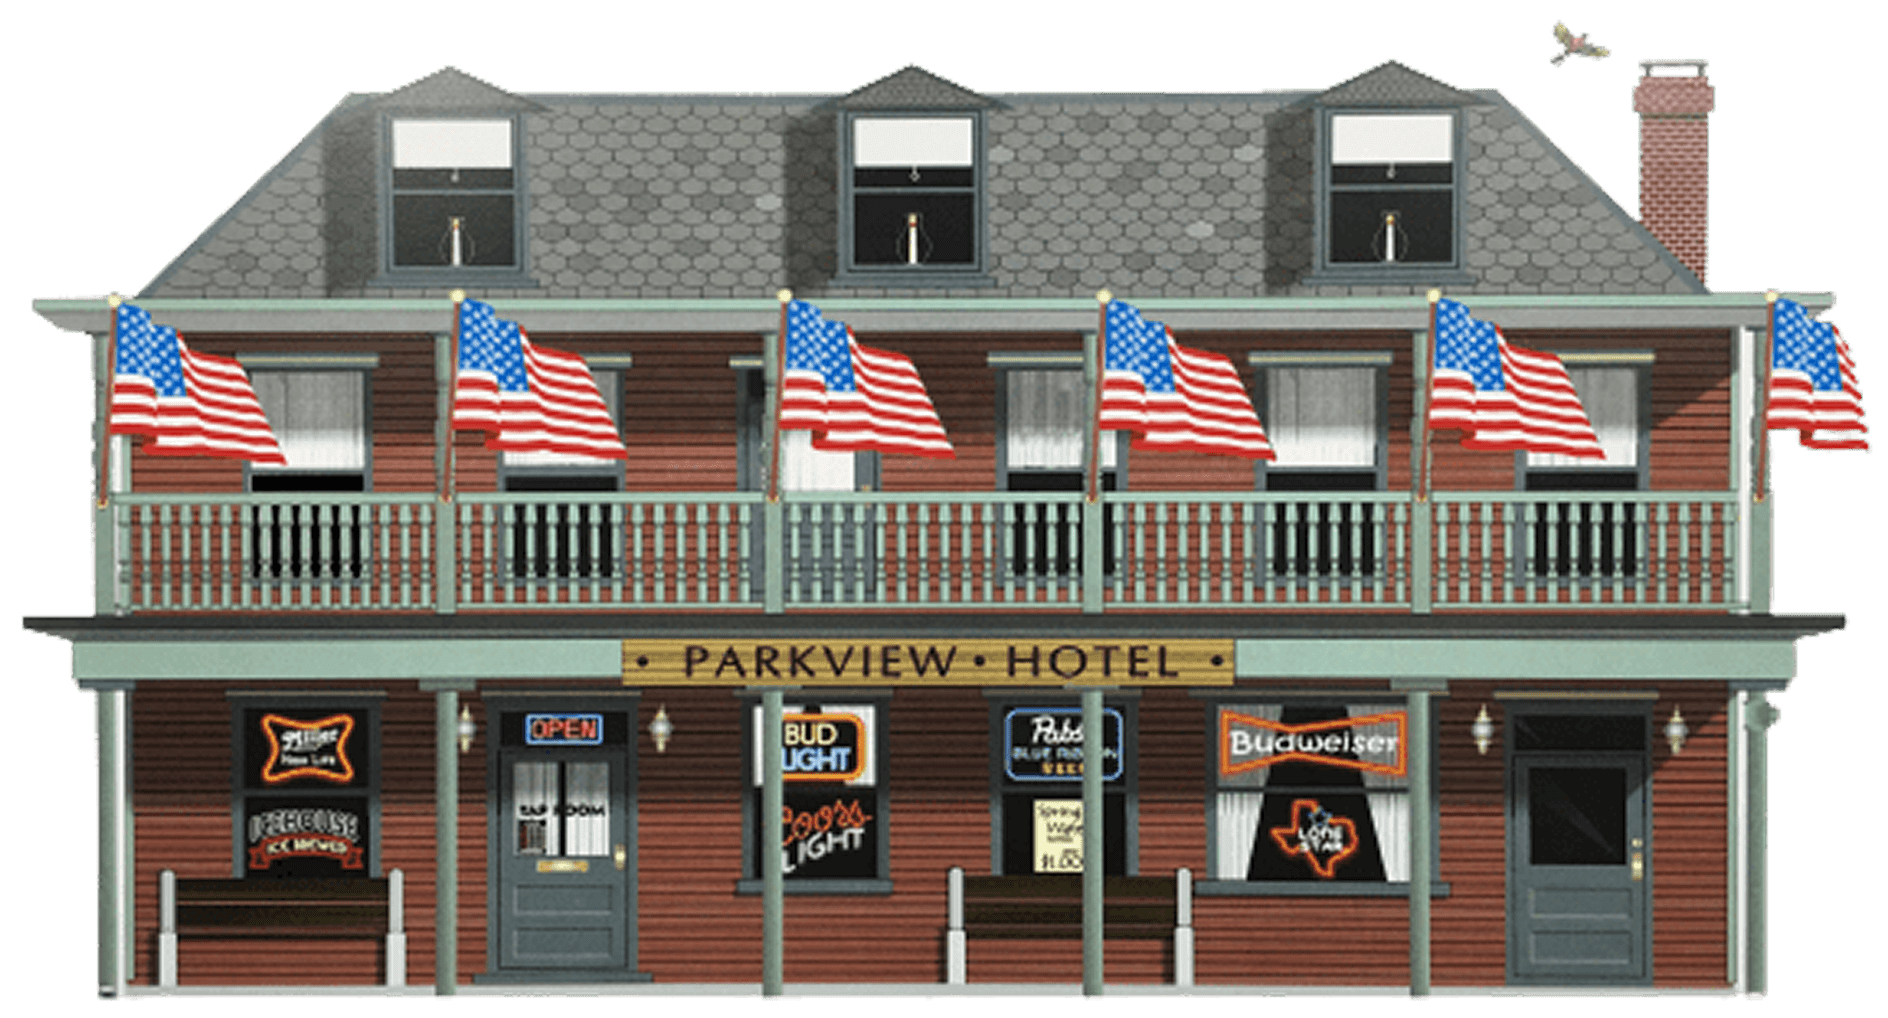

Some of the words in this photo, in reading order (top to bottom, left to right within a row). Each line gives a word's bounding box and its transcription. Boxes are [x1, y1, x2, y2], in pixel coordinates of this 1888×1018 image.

[684, 645, 957, 678] PARKVIEW
[1007, 645, 1180, 678] HOTEL
[531, 718, 598, 739] OPEN
[784, 722, 838, 746] BUD
[1228, 729, 1401, 756] Budweiser
